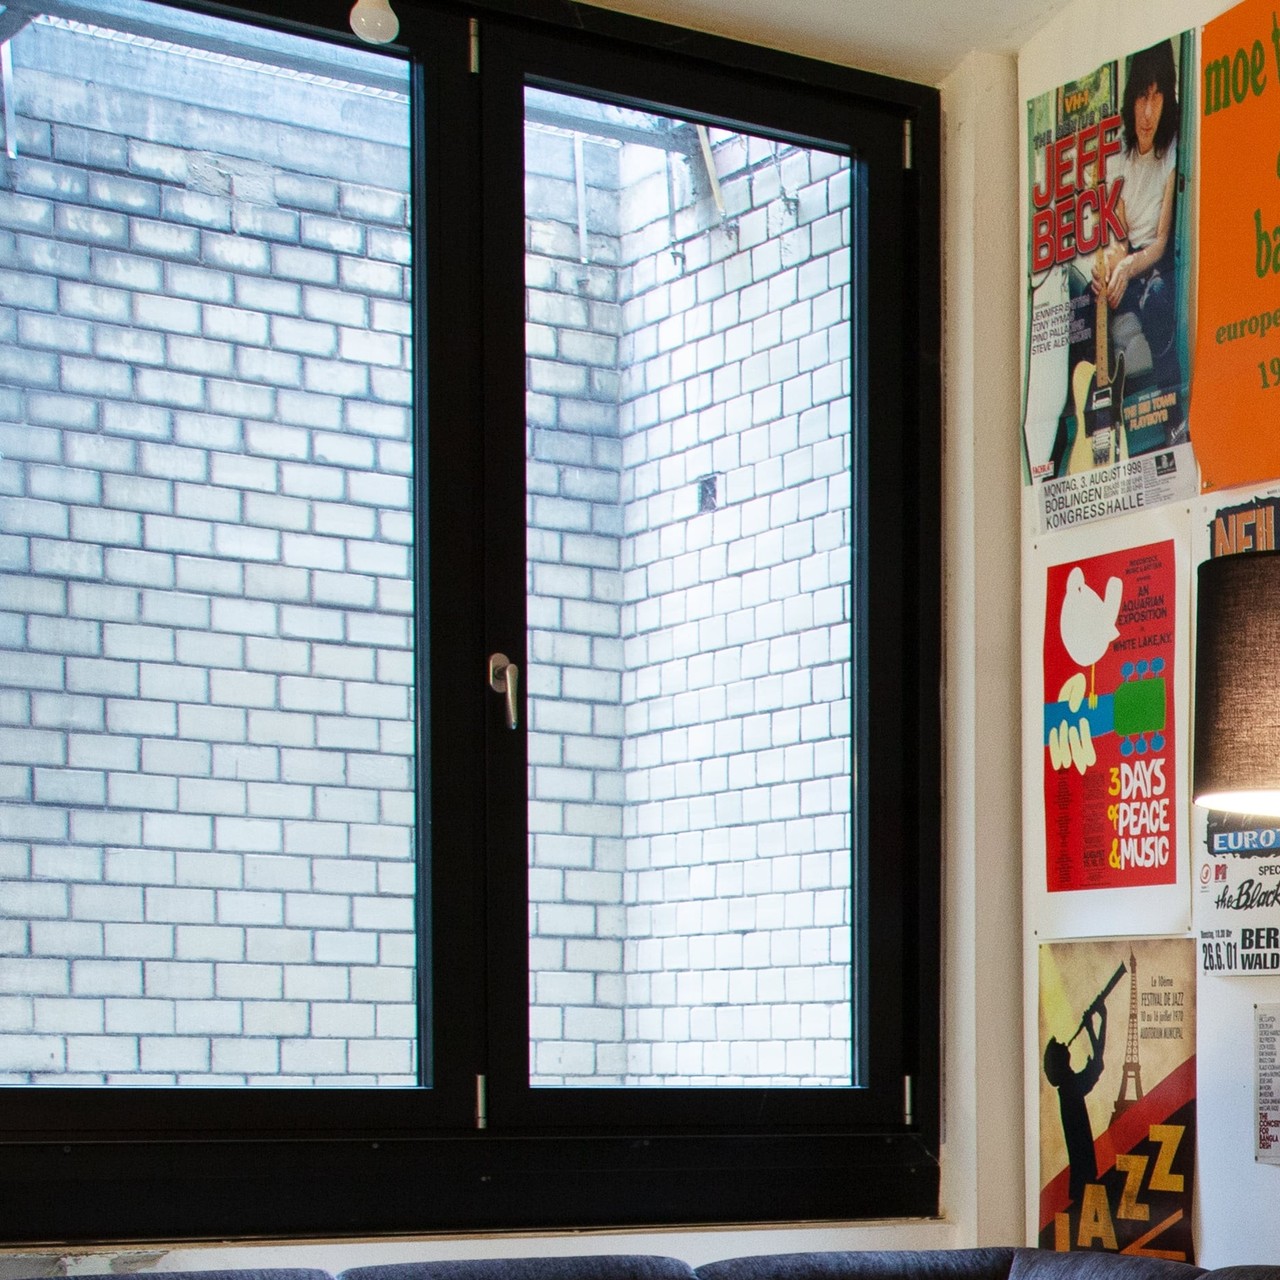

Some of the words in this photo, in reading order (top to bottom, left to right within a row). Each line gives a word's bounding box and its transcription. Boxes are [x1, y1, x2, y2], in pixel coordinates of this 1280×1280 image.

[1204, 39, 1267, 116] moe
[1032, 114, 1122, 209] JEFF
[1032, 176, 1128, 274] BECK
[1044, 478, 1078, 498] MONTAG,
[1090, 465, 1121, 486] AUGUST
[1123, 460, 1143, 476] 1998
[1046, 492, 1144, 530] KONGRESSHALLE
[1108, 767, 1121, 796] 3
[1120, 758, 1166, 800] DAYS
[1118, 798, 1170, 837] PEACE
[1120, 836, 1170, 871] MUSIC
[1215, 884, 1233, 910] the
